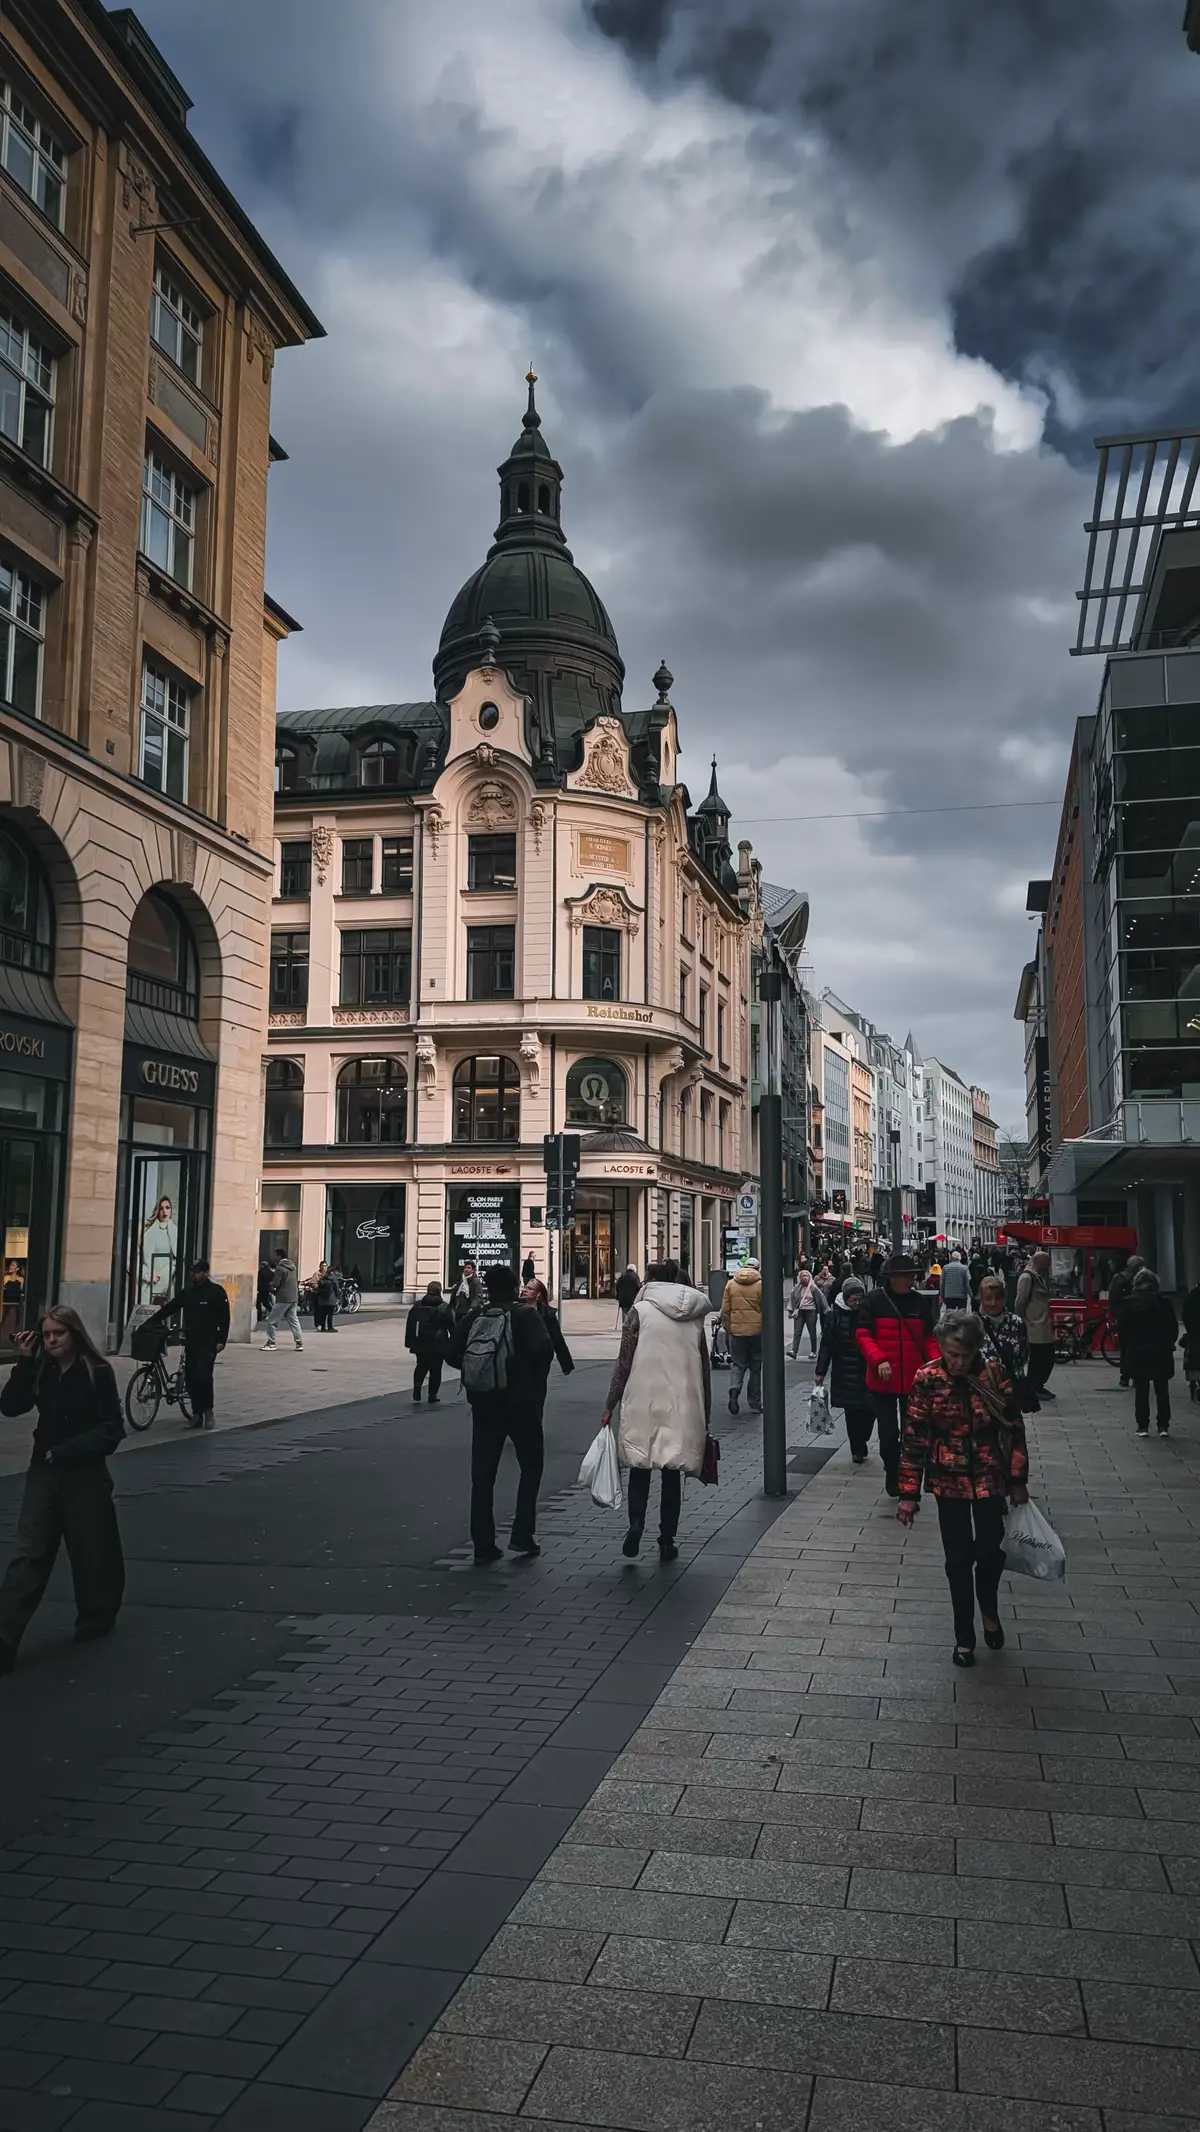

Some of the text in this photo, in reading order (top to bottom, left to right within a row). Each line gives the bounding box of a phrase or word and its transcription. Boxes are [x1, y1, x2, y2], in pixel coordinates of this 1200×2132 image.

[587, 1005, 653, 1023] Reichshof
[143, 1060, 199, 1092] GUESS
[451, 1166, 492, 1174] LACOSTE
[604, 1165, 644, 1174] LACOSTE
